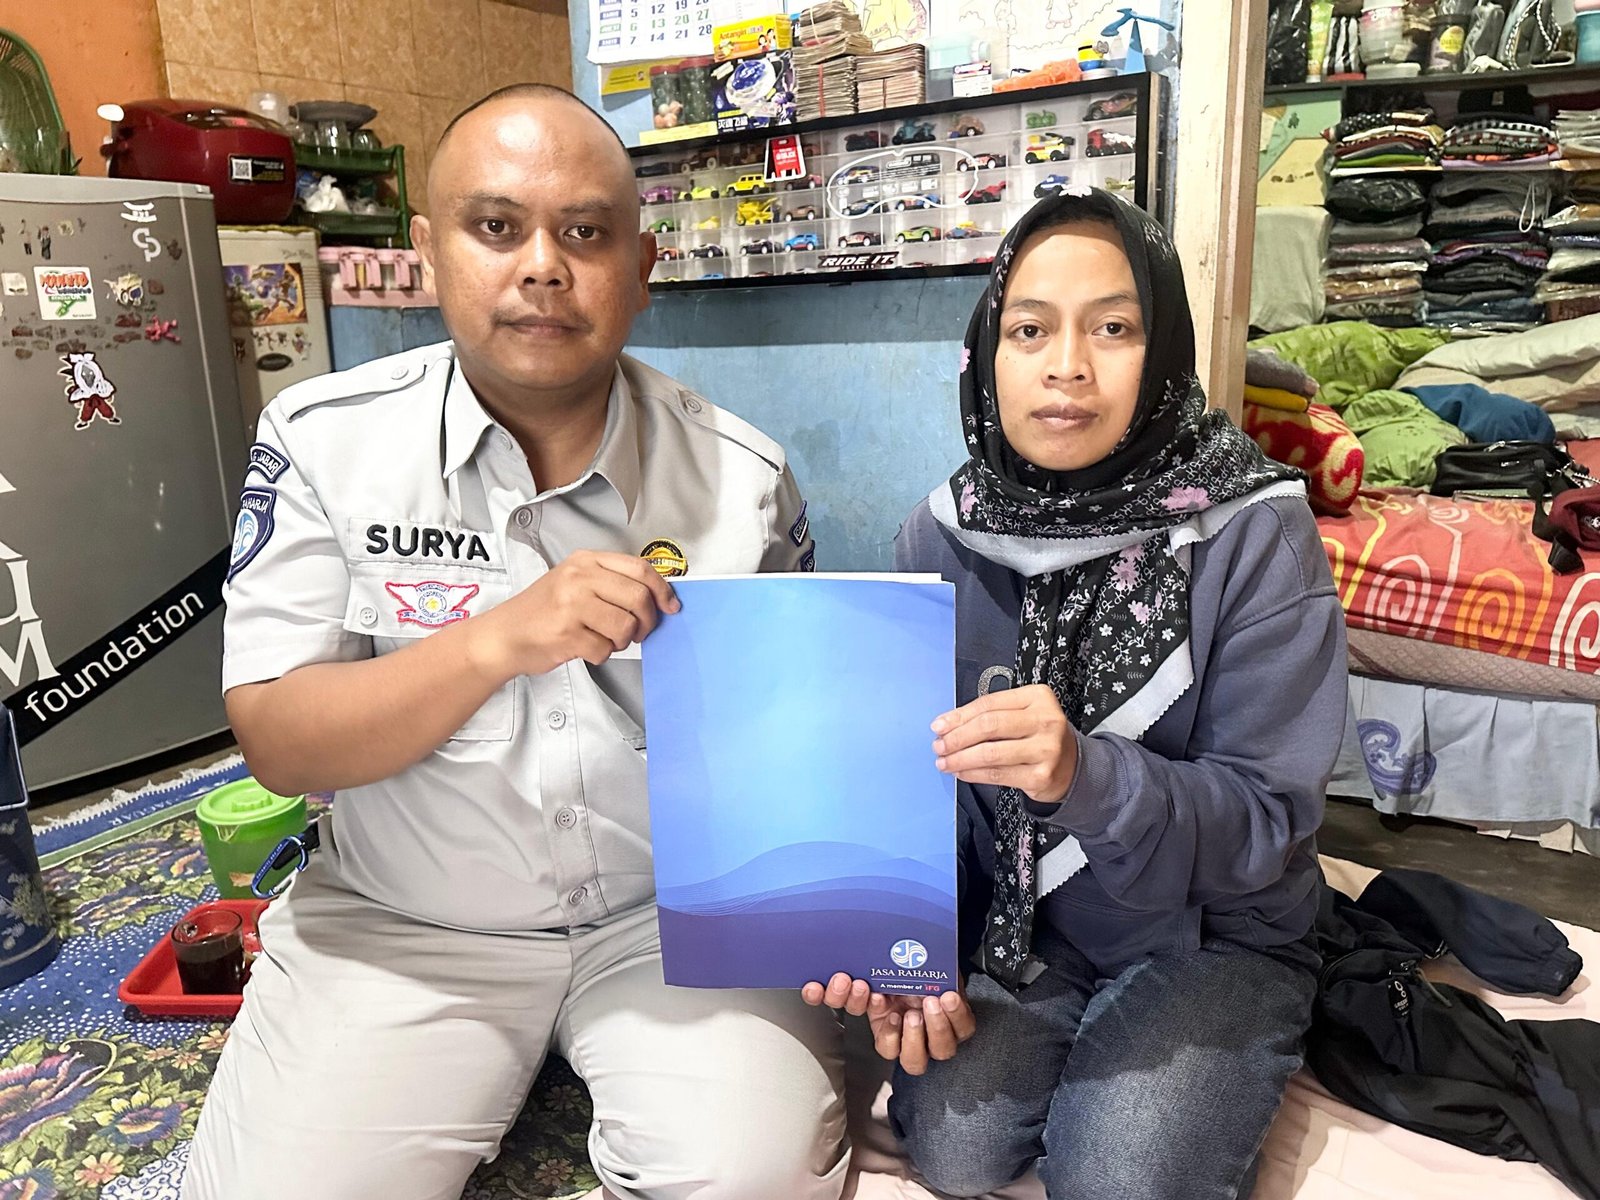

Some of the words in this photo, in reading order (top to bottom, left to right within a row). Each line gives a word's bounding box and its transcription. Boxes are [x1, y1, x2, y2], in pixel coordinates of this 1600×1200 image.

[630, 8, 638, 18] 5
[651, 4, 665, 15] 12
[675, 0, 688, 10] 19
[630, 22, 638, 32] 6
[651, 18, 665, 29] 13
[675, 14, 690, 25] 20
[697, 9, 710, 21] 27
[630, 36, 636, 45] 7
[651, 32, 665, 42] 14
[675, 29, 688, 39] 21
[698, 24, 712, 36] 28
[822, 256, 870, 267] RIDE
[871, 254, 896, 264] IT
[366, 524, 490, 561] SURYA
[24, 592, 204, 722] foundation
[871, 968, 895, 977] JASA
[898, 969, 948, 980] RAHARJA
